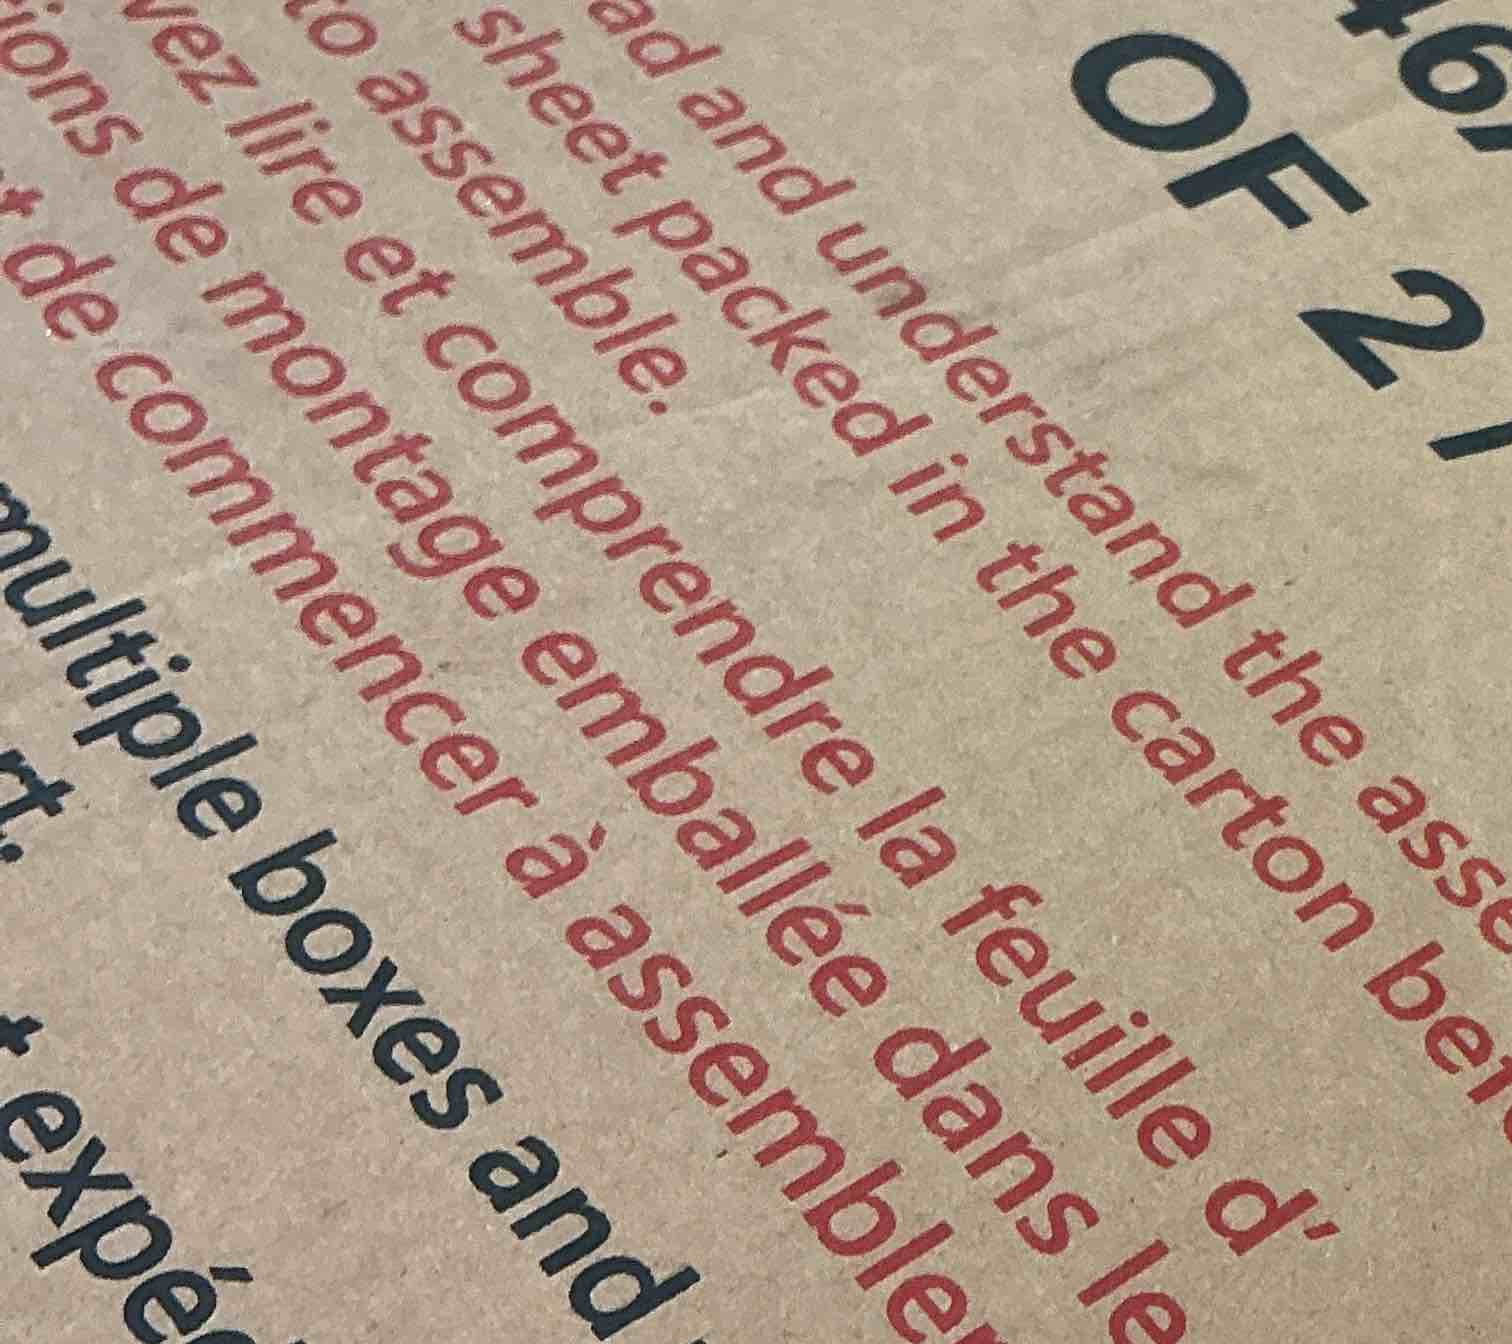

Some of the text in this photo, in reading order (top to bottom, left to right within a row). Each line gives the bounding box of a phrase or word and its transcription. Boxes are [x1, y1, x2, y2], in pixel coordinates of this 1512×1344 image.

[356, 68, 688, 415] assemble.
[454, 6, 672, 196] sheet
[611, 200, 932, 456] packed
[889, 453, 986, 542] in
[976, 542, 1118, 680] the
[1111, 690, 1375, 952] carton
[679, 87, 856, 214] and
[817, 223, 1255, 628] understand
[1223, 628, 1365, 767] the
[1070, 33, 1370, 229] OF
[1298, 268, 1484, 391] 2
[2, 243, 120, 340] de
[95, 352, 539, 815] commencer
[504, 822, 606, 898] à
[114, 167, 229, 262] de
[202, 271, 541, 618] montage
[521, 631, 888, 1017] emballée
[873, 1027, 1100, 1255] dans
[225, 100, 363, 224] lire
[344, 235, 456, 315] et
[423, 323, 875, 794] comprendre
[857, 786, 956, 889] la
[941, 883, 1211, 1167] feuille
[228, 828, 504, 1129] boxes
[468, 1135, 702, 1341] and
